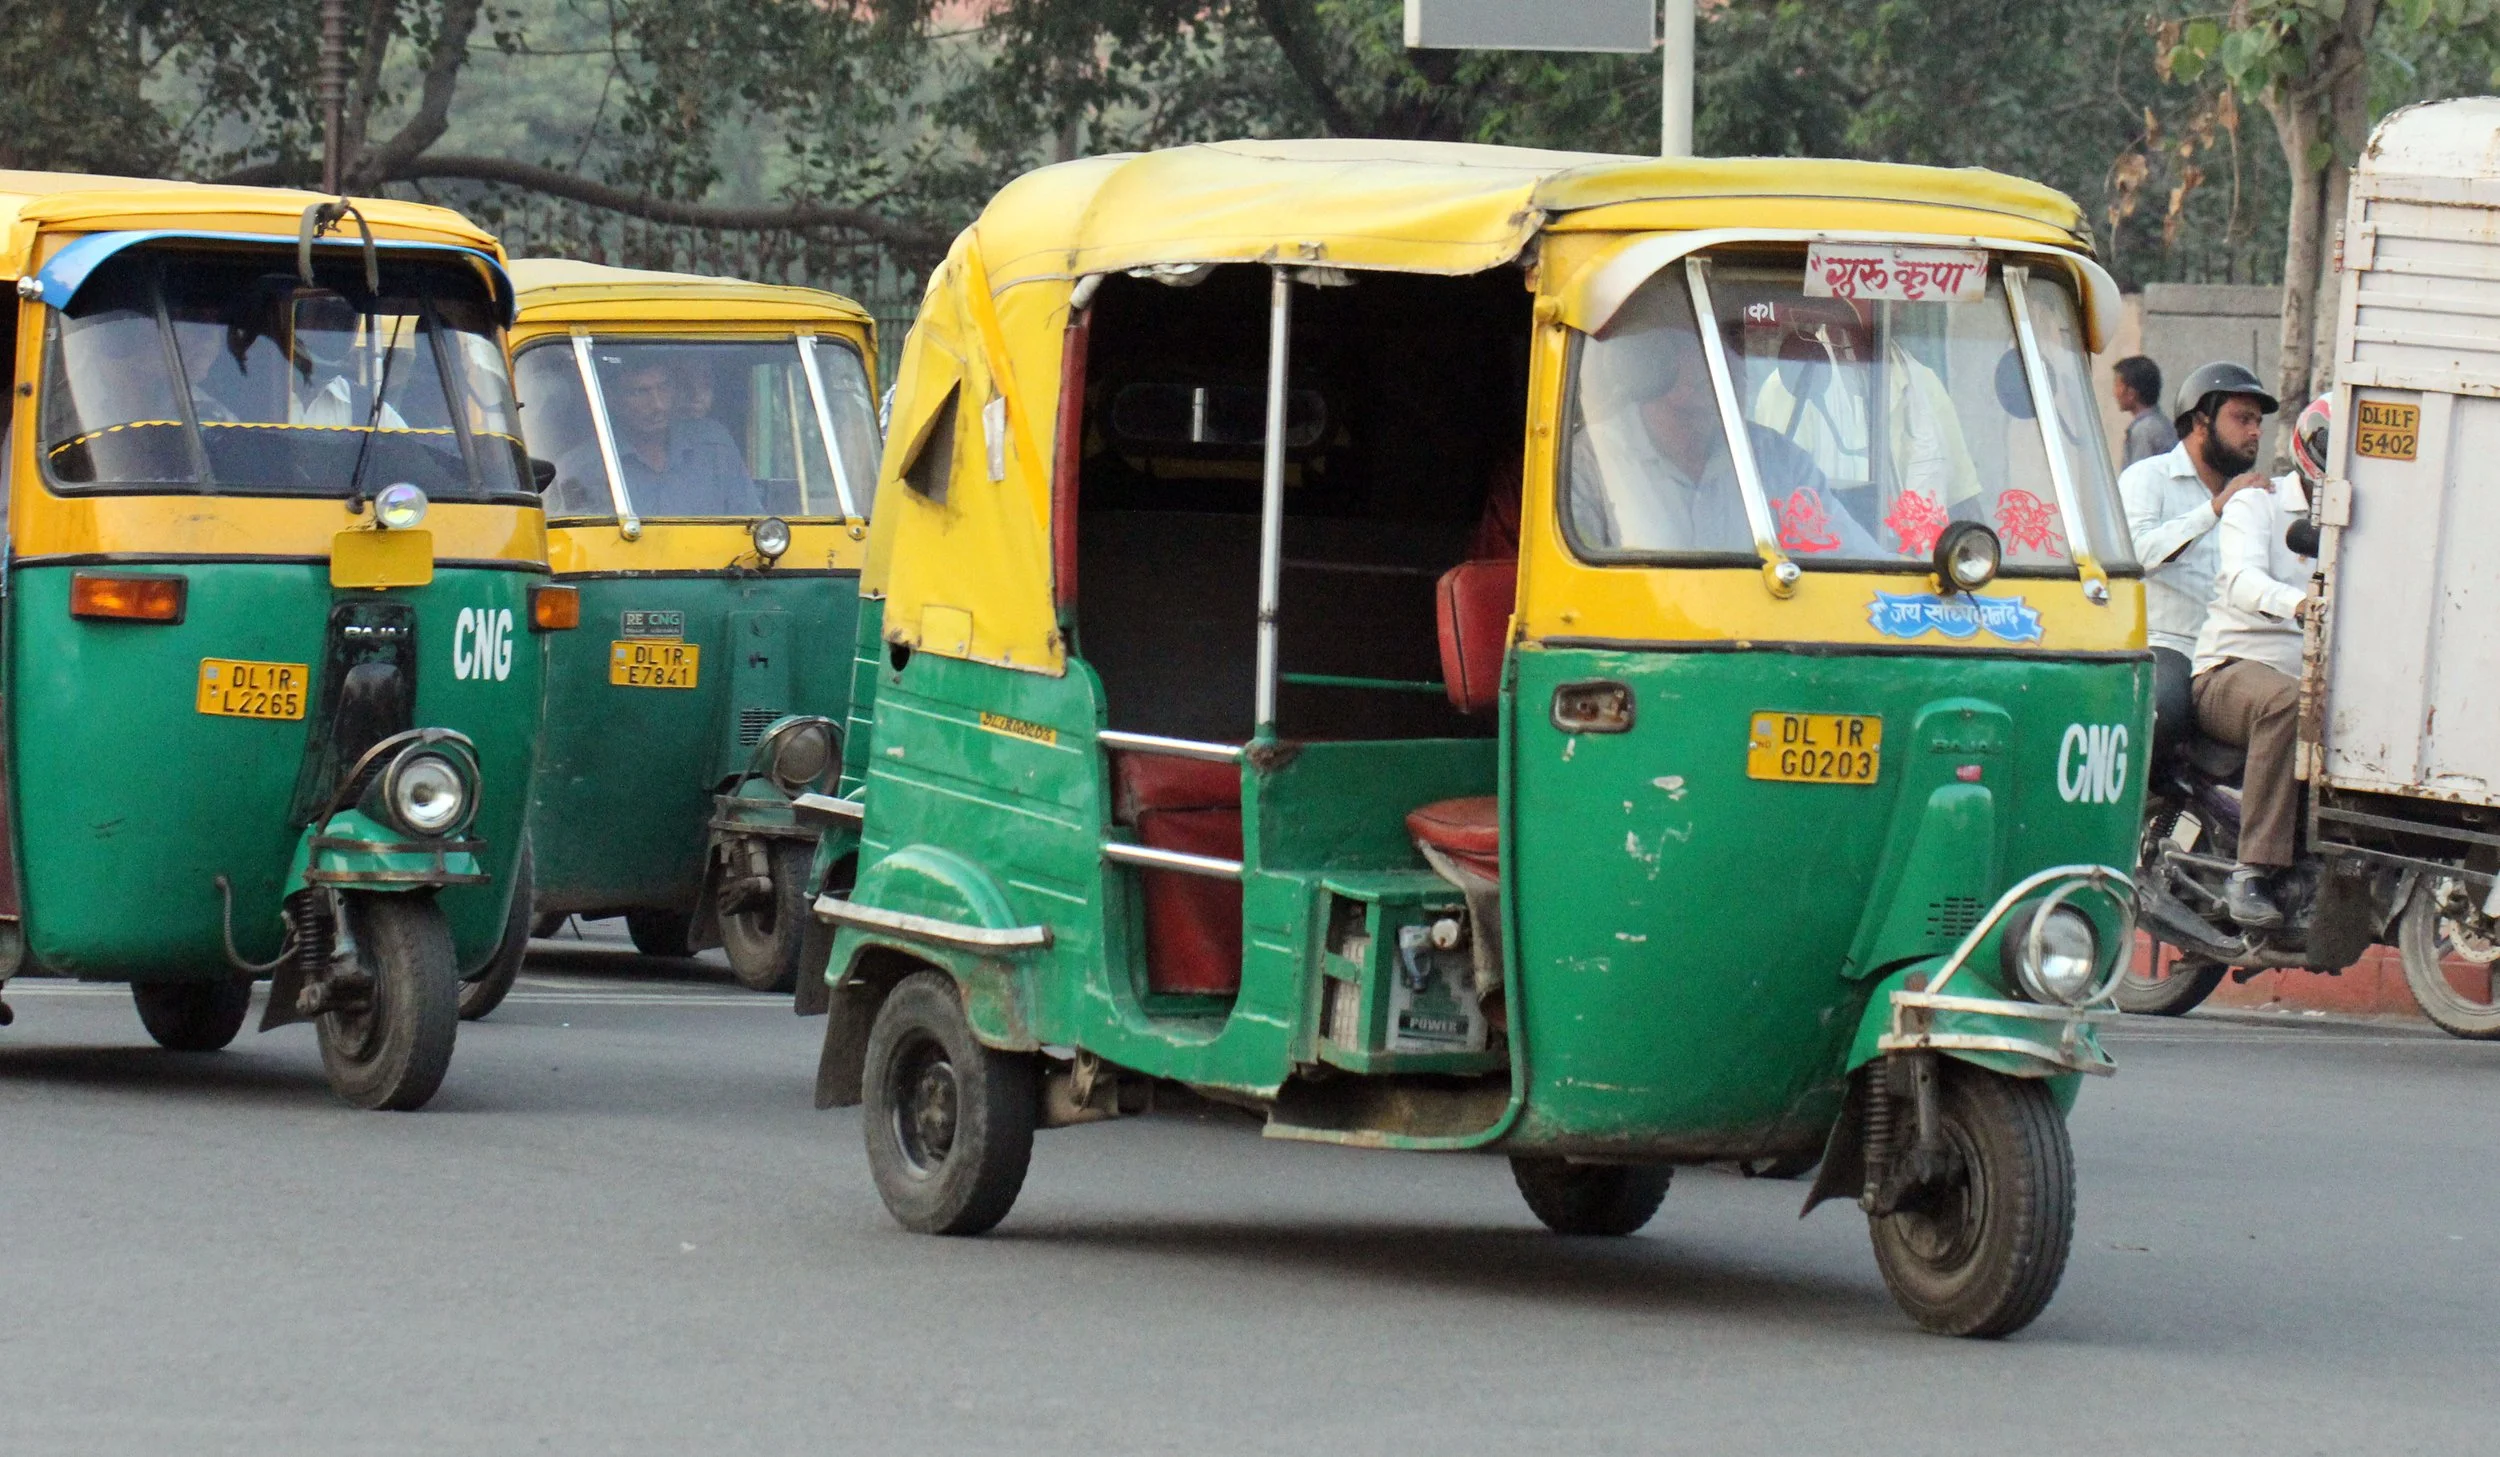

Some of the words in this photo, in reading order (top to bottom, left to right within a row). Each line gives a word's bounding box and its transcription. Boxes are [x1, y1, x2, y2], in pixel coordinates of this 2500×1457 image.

[2361, 433, 2414, 455] 5402
[626, 613, 644, 626] RE
[648, 613, 680, 626] CNG
[1890, 603, 1921, 623] जय
[453, 606, 513, 682] CNG
[629, 665, 688, 686] E7841
[223, 690, 298, 716] L2265
[1783, 716, 1816, 745] DL
[1835, 719, 1864, 748] 1R
[1781, 748, 1872, 779] G0203
[2056, 723, 2129, 805] CNG
[1409, 1017, 1458, 1034] POWER
